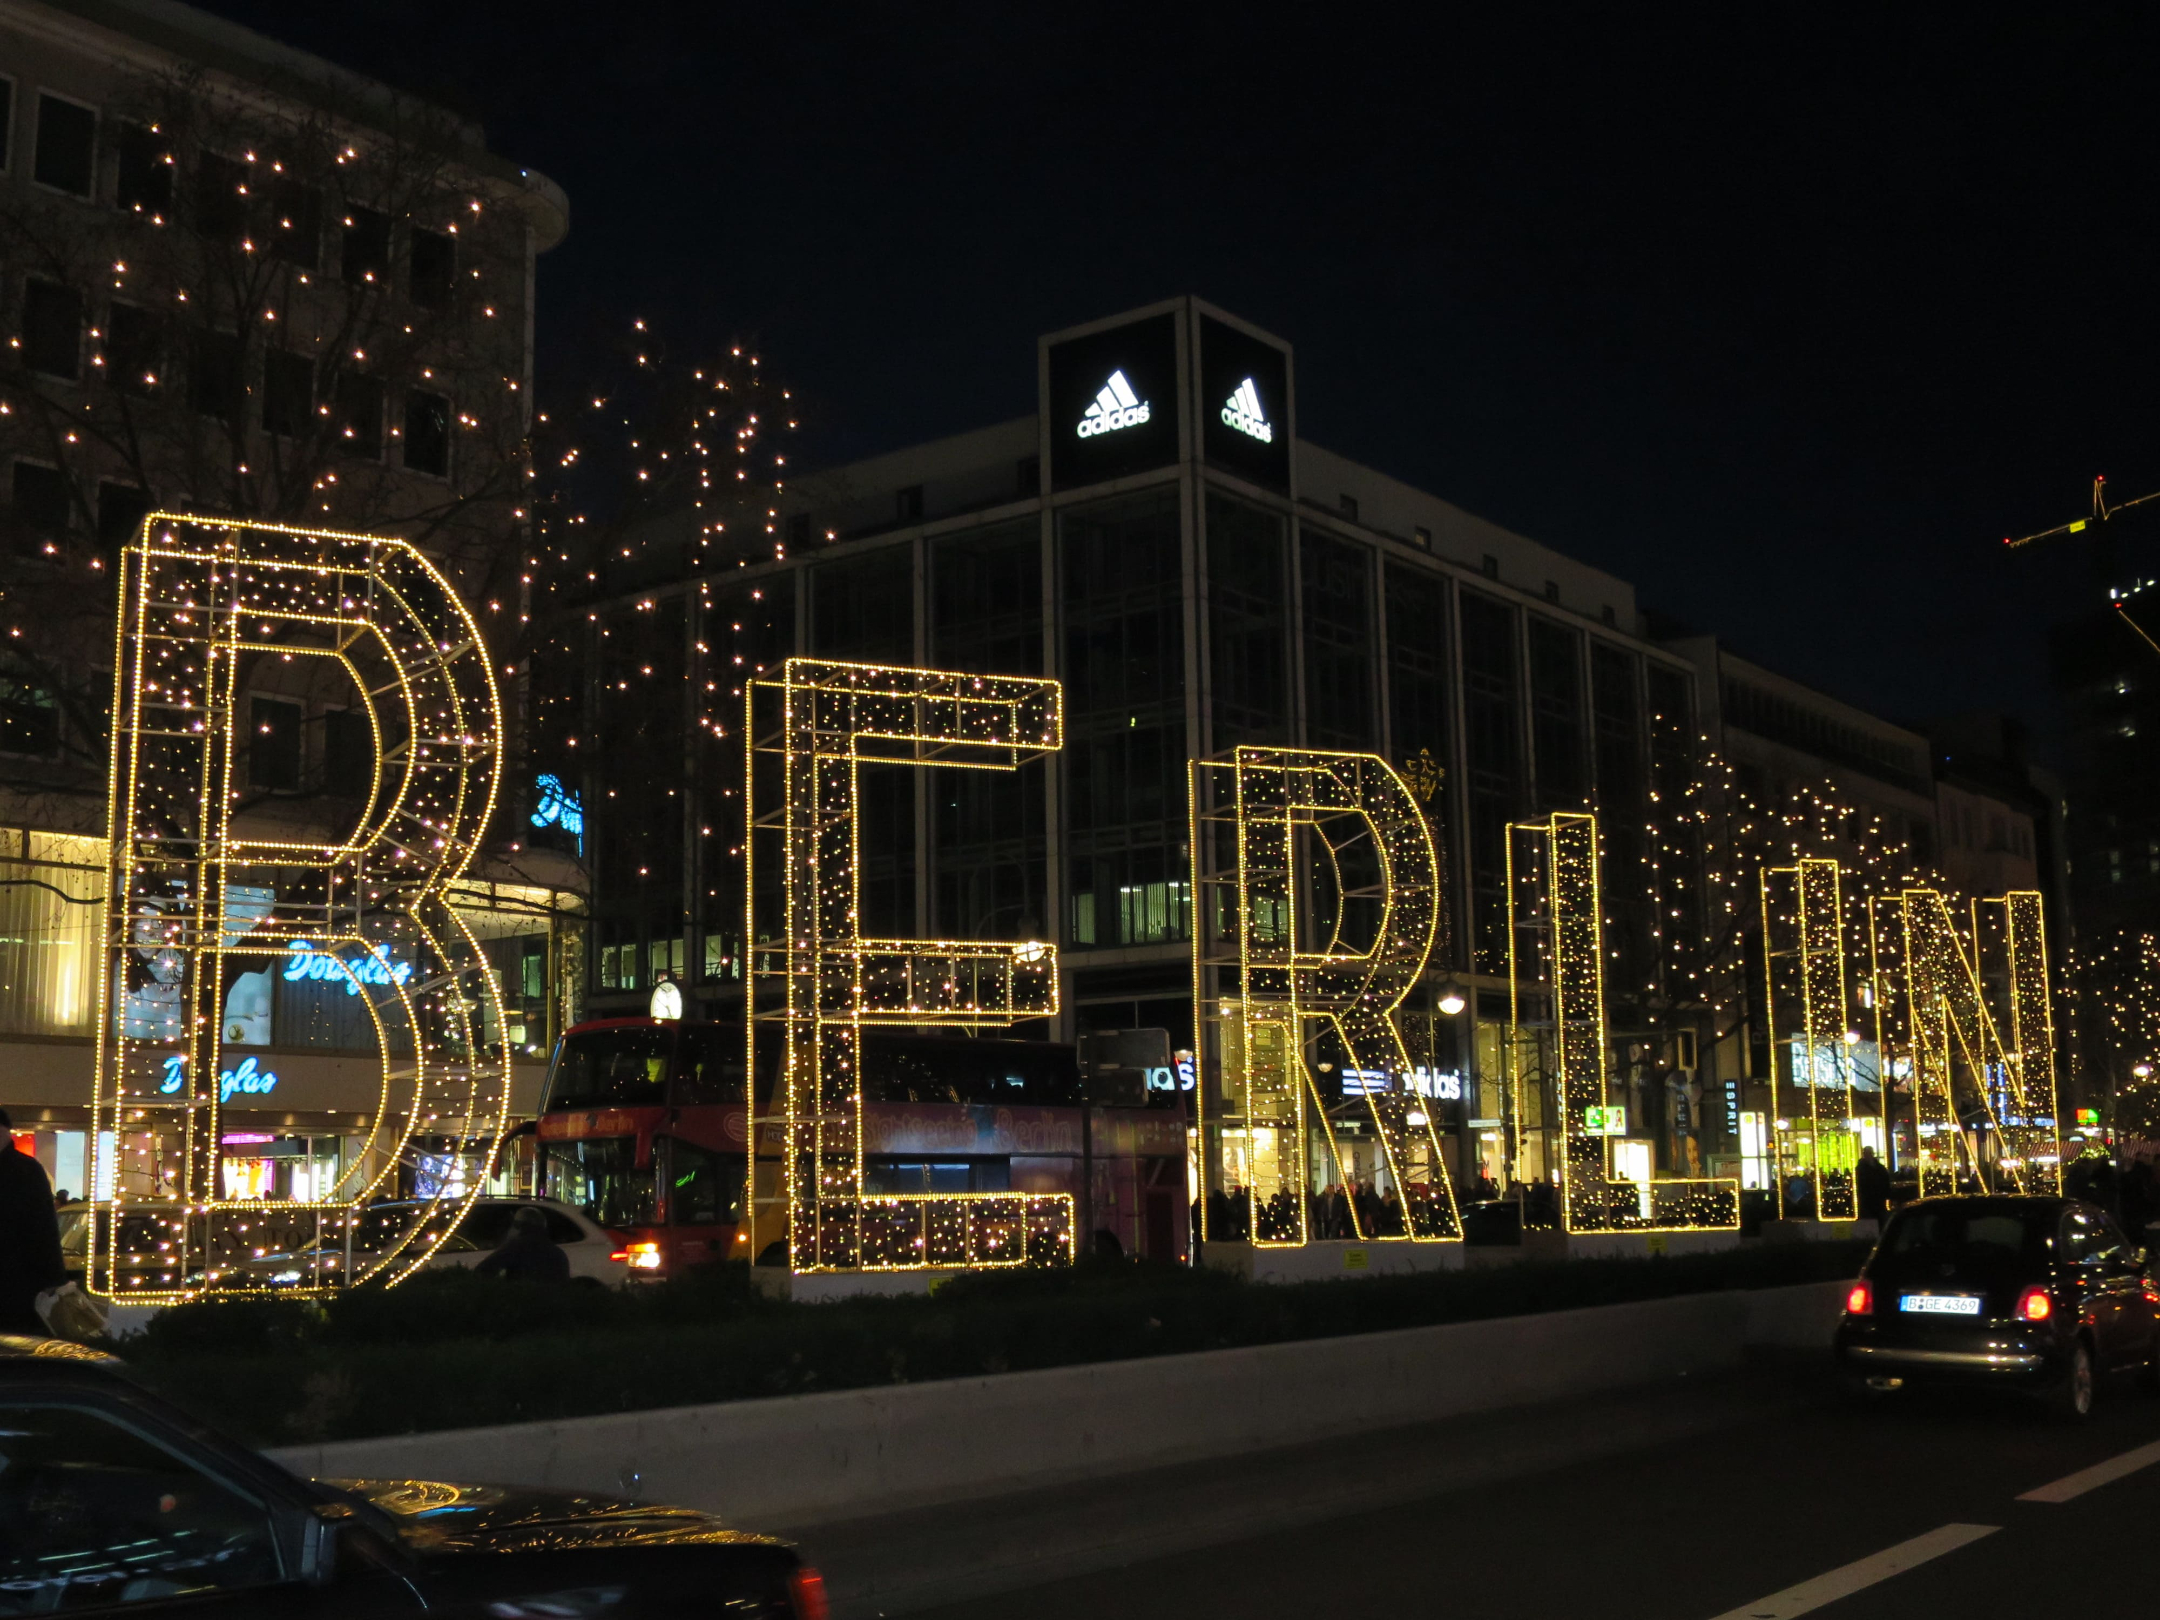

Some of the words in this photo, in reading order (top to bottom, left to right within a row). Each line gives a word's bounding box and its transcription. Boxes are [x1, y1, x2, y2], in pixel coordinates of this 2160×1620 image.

[1076, 404, 1150, 438] adidas
[1221, 407, 1272, 443] adidas
[85, 510, 2062, 1308] BERLIN
[283, 939, 412, 996] Douglas
[160, 1056, 278, 1103] Dglas
[994, 1108, 1073, 1152] Berlin
[1724, 1081, 1739, 1136] ESPRIT
[1909, 1298, 1917, 1309] B
[1926, 1299, 1941, 1310] GE
[1944, 1299, 1977, 1311] 4369
